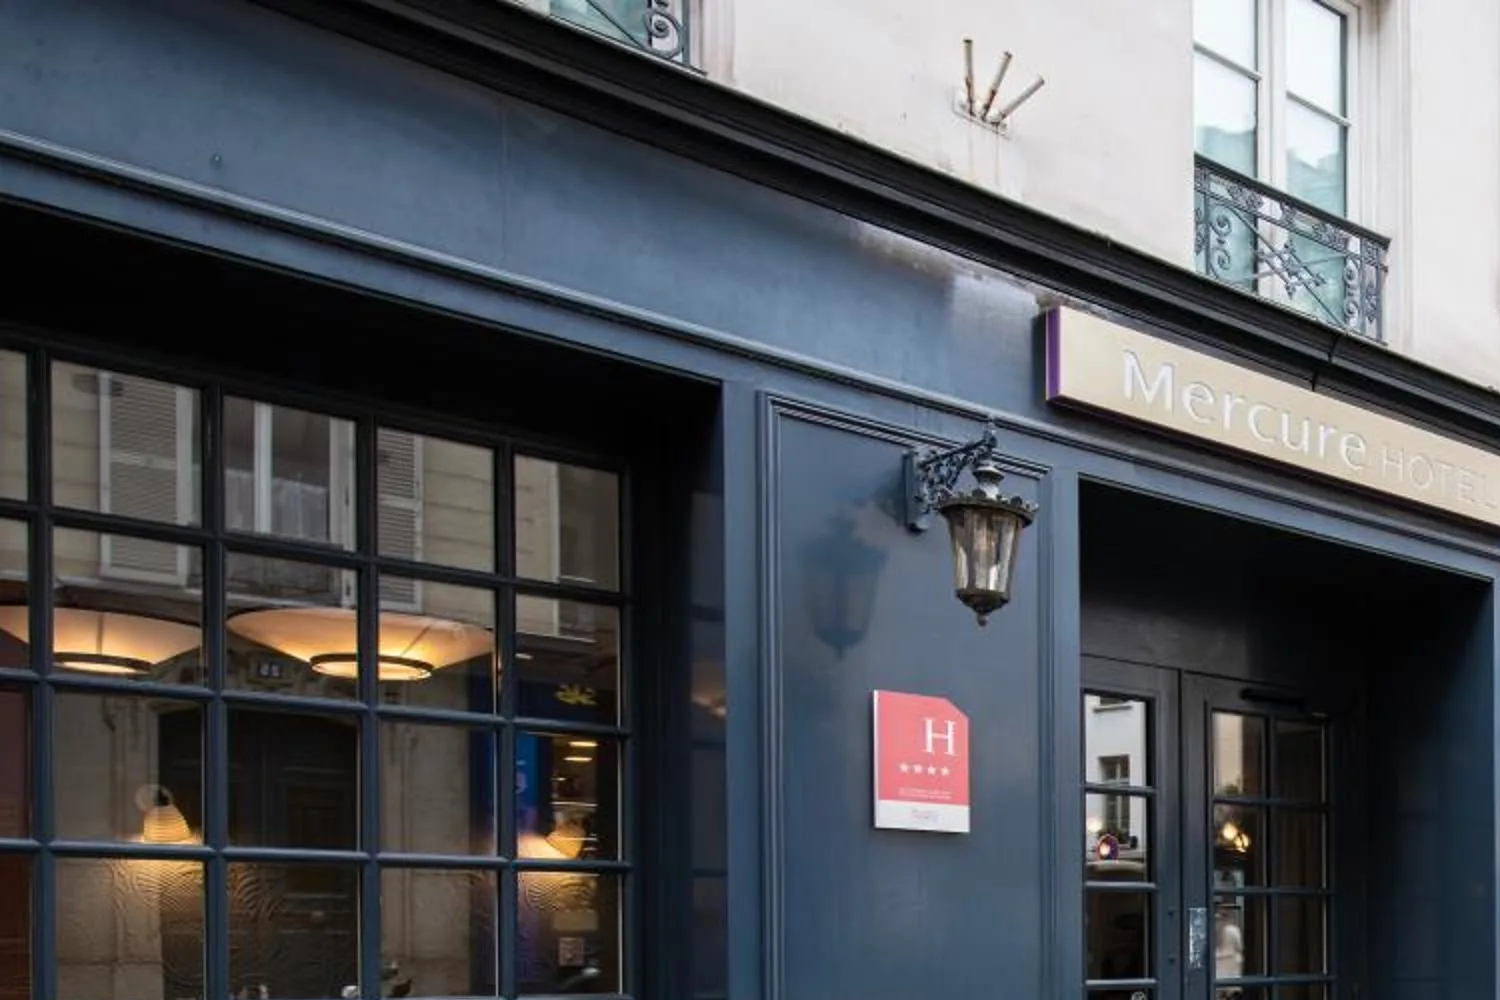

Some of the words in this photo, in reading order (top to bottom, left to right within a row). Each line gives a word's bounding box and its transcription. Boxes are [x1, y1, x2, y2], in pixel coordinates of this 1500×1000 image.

[1123, 350, 1367, 471] Mercure
[1383, 445, 1496, 510] HOTEL
[922, 717, 957, 756] H
